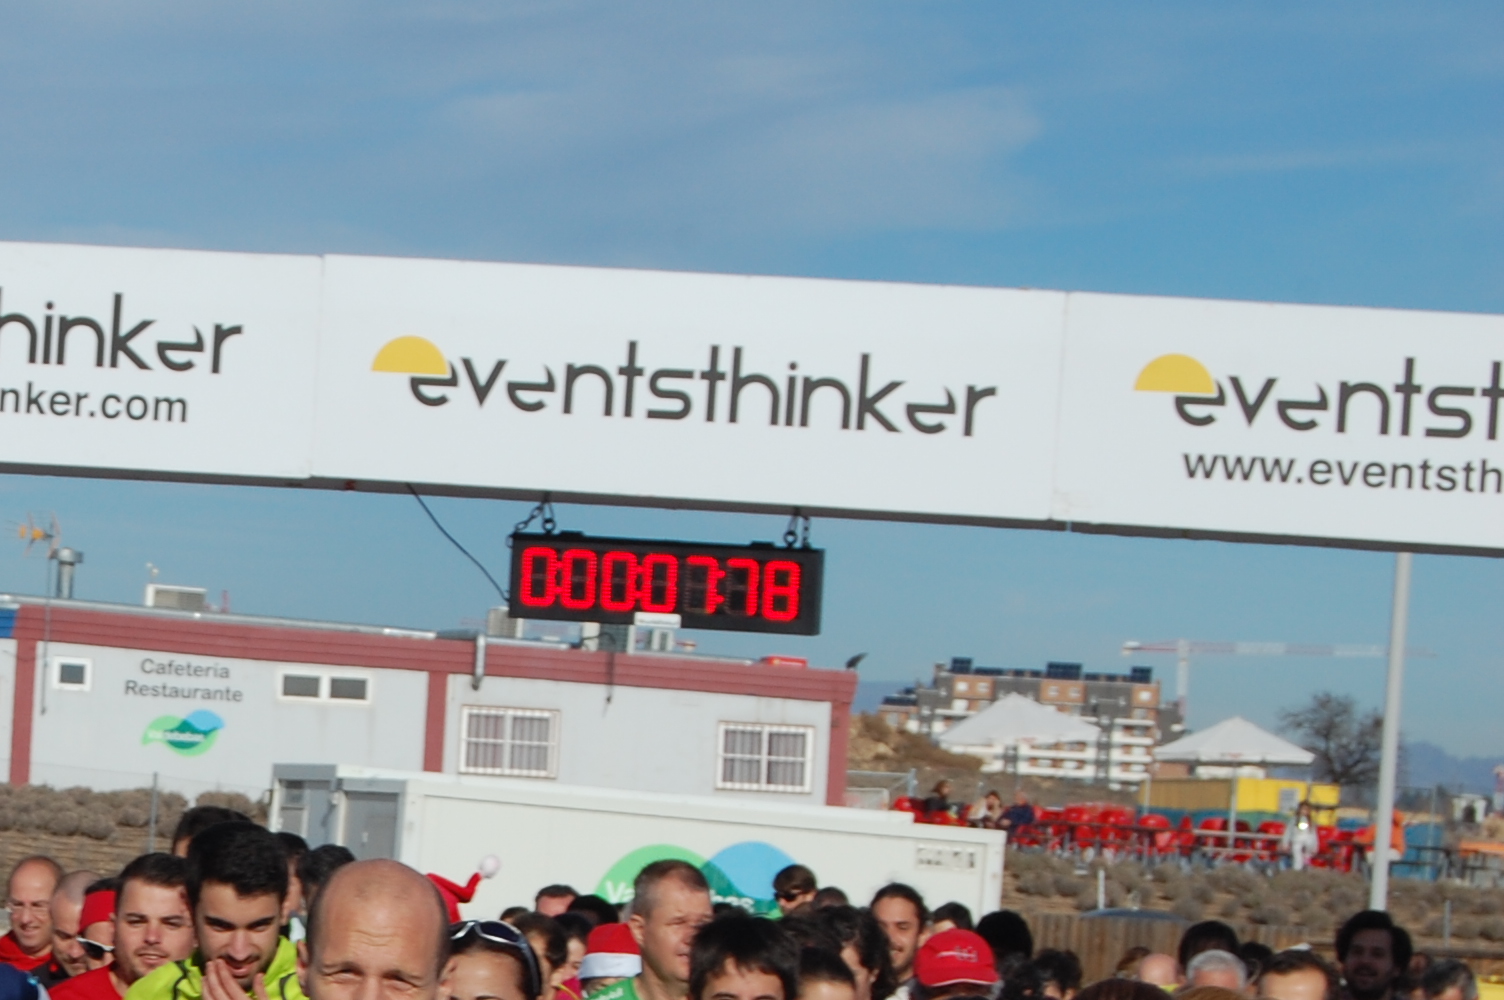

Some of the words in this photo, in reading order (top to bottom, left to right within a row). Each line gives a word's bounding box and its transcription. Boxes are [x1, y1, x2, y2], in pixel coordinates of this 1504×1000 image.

[409, 340, 997, 437] eventsthinker
[1182, 453, 1504, 494] www.eventsth
[124, 680, 244, 702] Restaurante
